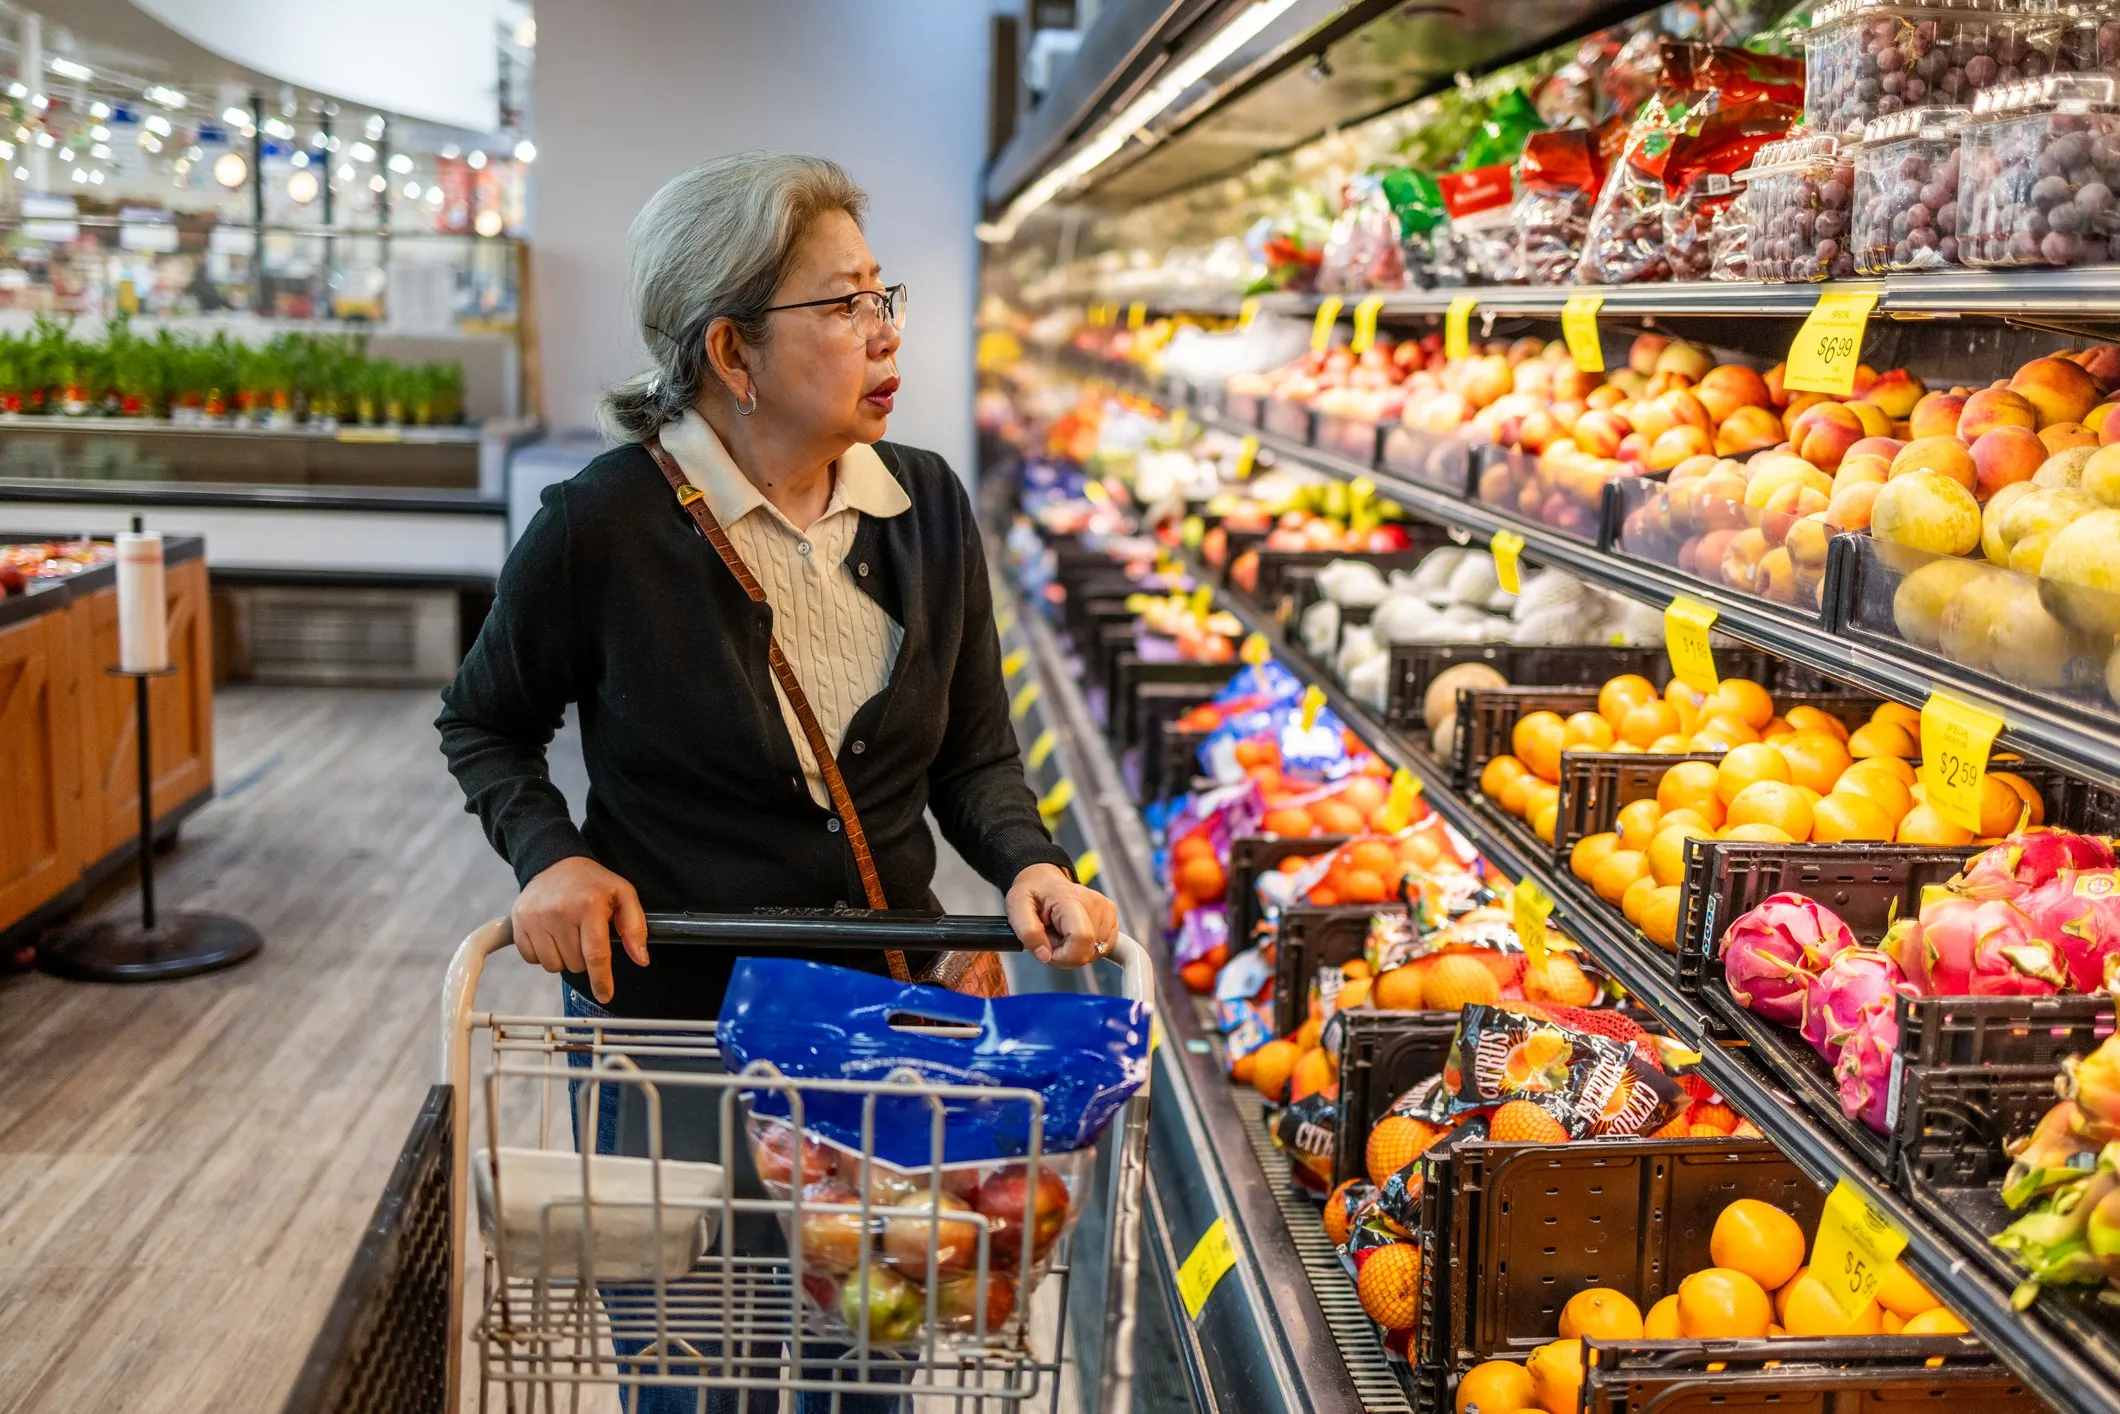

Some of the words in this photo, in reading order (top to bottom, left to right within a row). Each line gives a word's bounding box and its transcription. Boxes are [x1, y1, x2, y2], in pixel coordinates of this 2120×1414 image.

[1940, 752, 1978, 789] $259
[1474, 1028, 1510, 1100] CITRUS
[1845, 1251, 1877, 1294] $59
